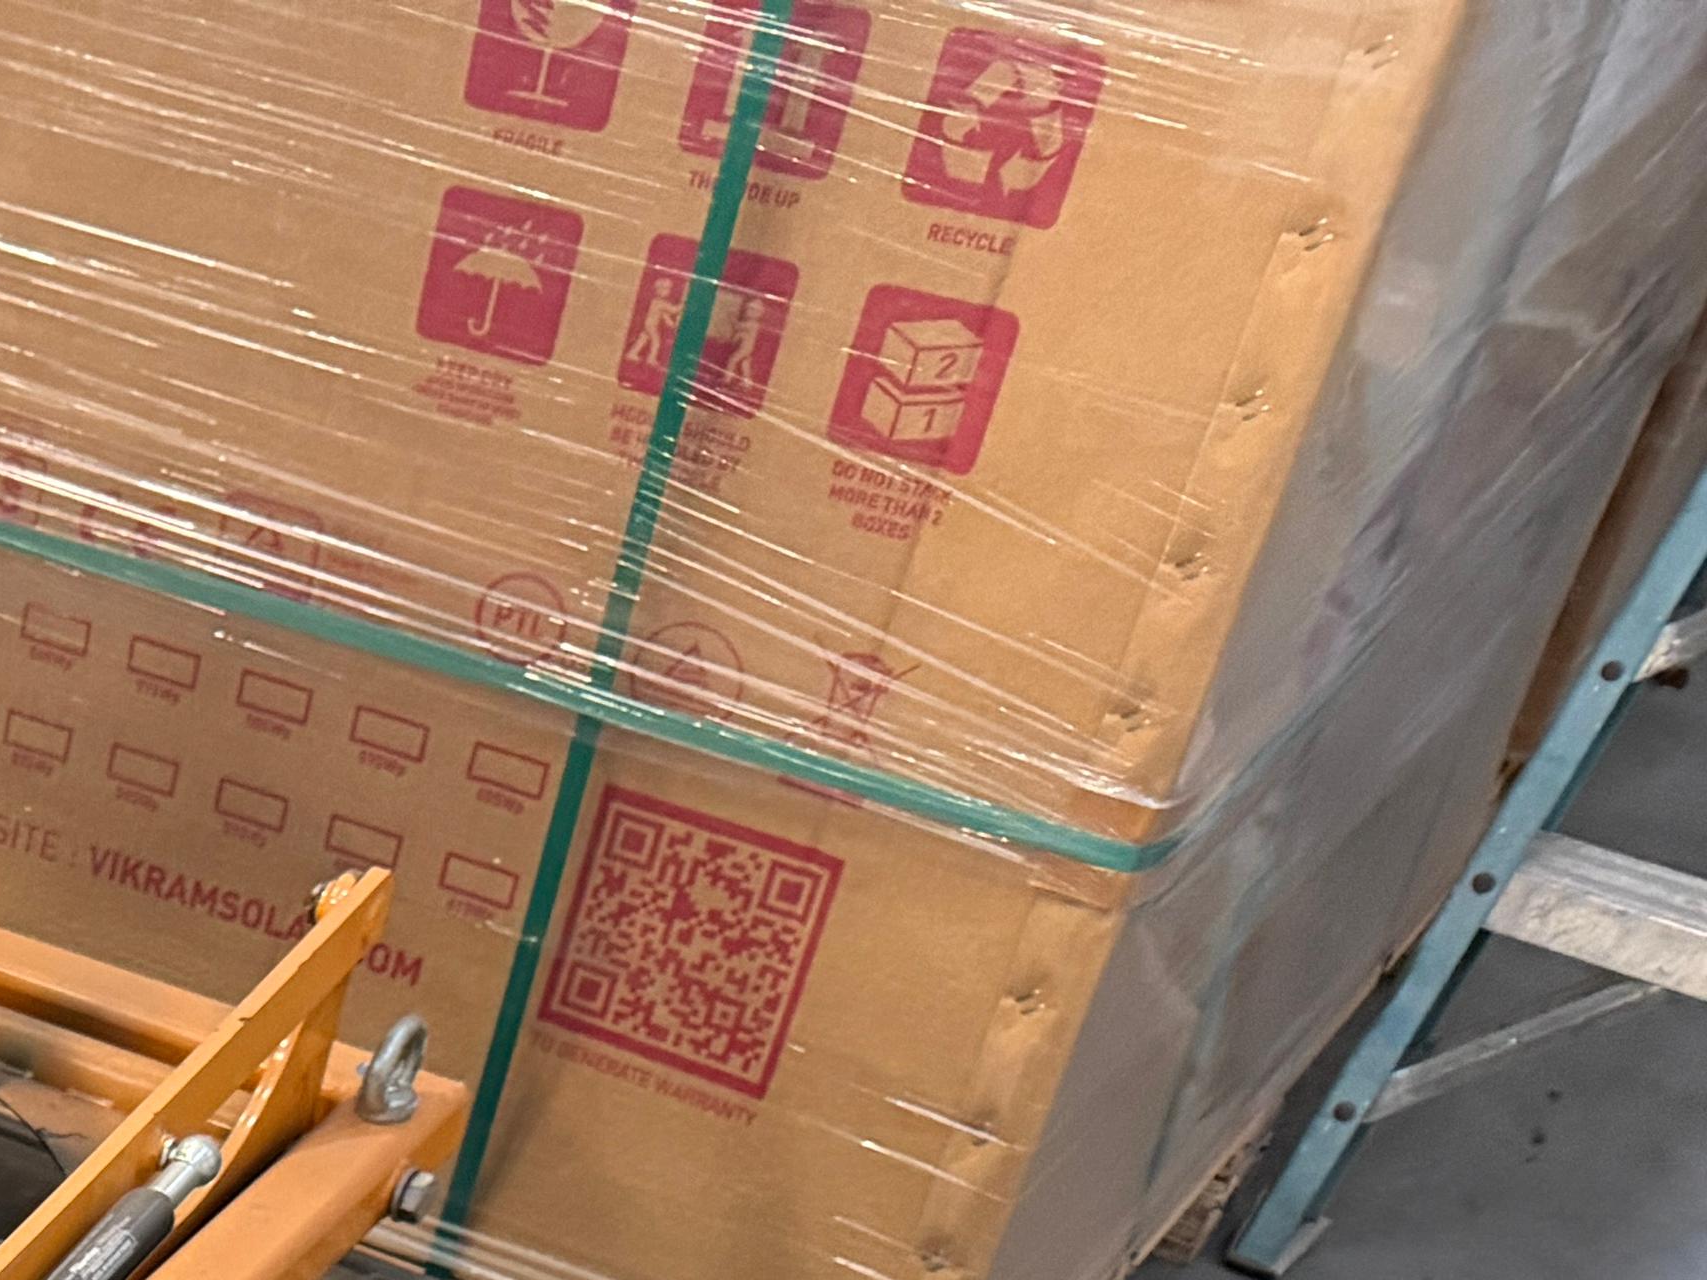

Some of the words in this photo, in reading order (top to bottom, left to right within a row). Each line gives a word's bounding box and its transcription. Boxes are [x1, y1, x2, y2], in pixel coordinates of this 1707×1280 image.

[926, 222, 1015, 255] RECYCLE
[828, 485, 884, 508] MORE
[885, 492, 931, 521] THAN
